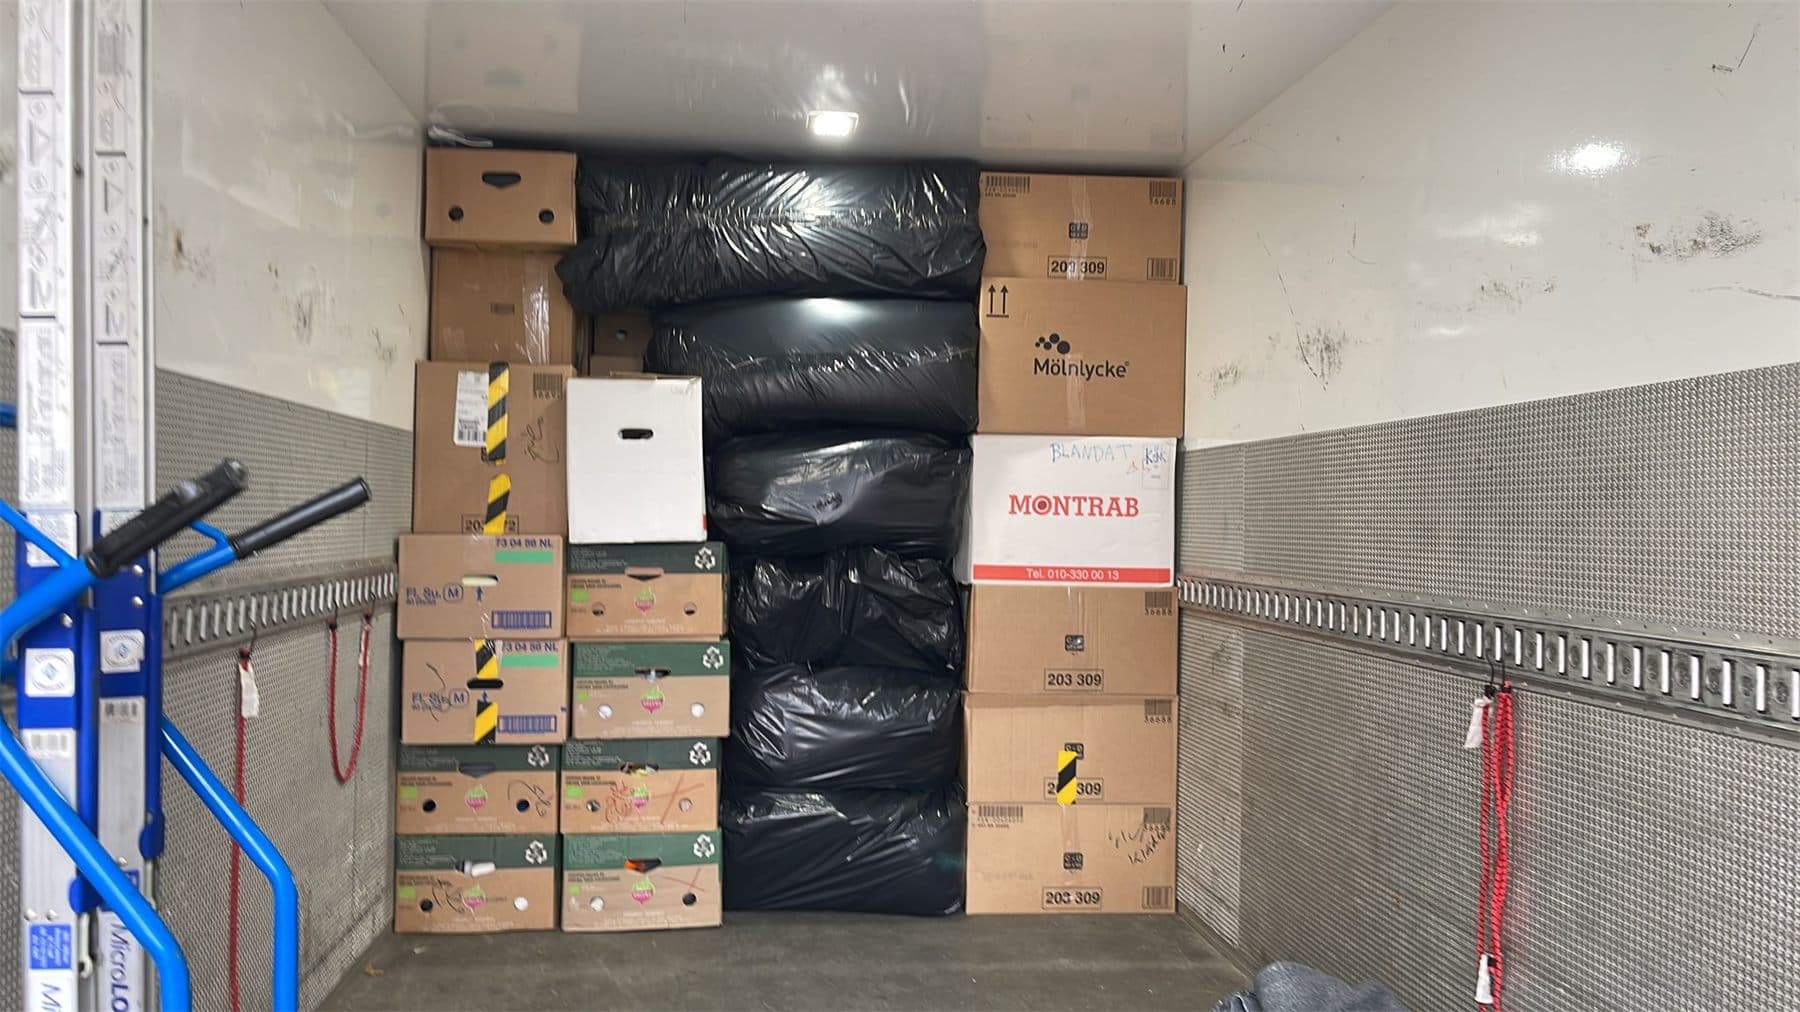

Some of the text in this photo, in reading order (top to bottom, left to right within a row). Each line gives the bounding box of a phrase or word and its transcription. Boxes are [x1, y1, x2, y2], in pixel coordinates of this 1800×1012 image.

[1050, 260, 1105, 274] 203 309
[1008, 494, 1140, 518] MONTRAB
[539, 538, 553, 549] NL
[1026, 567, 1120, 580] Tel. 010-330 00 13
[544, 642, 558, 651] NL
[1047, 673, 1102, 687] 203 309
[1076, 782, 1102, 795] 309
[1045, 892, 1100, 905] 203 309
